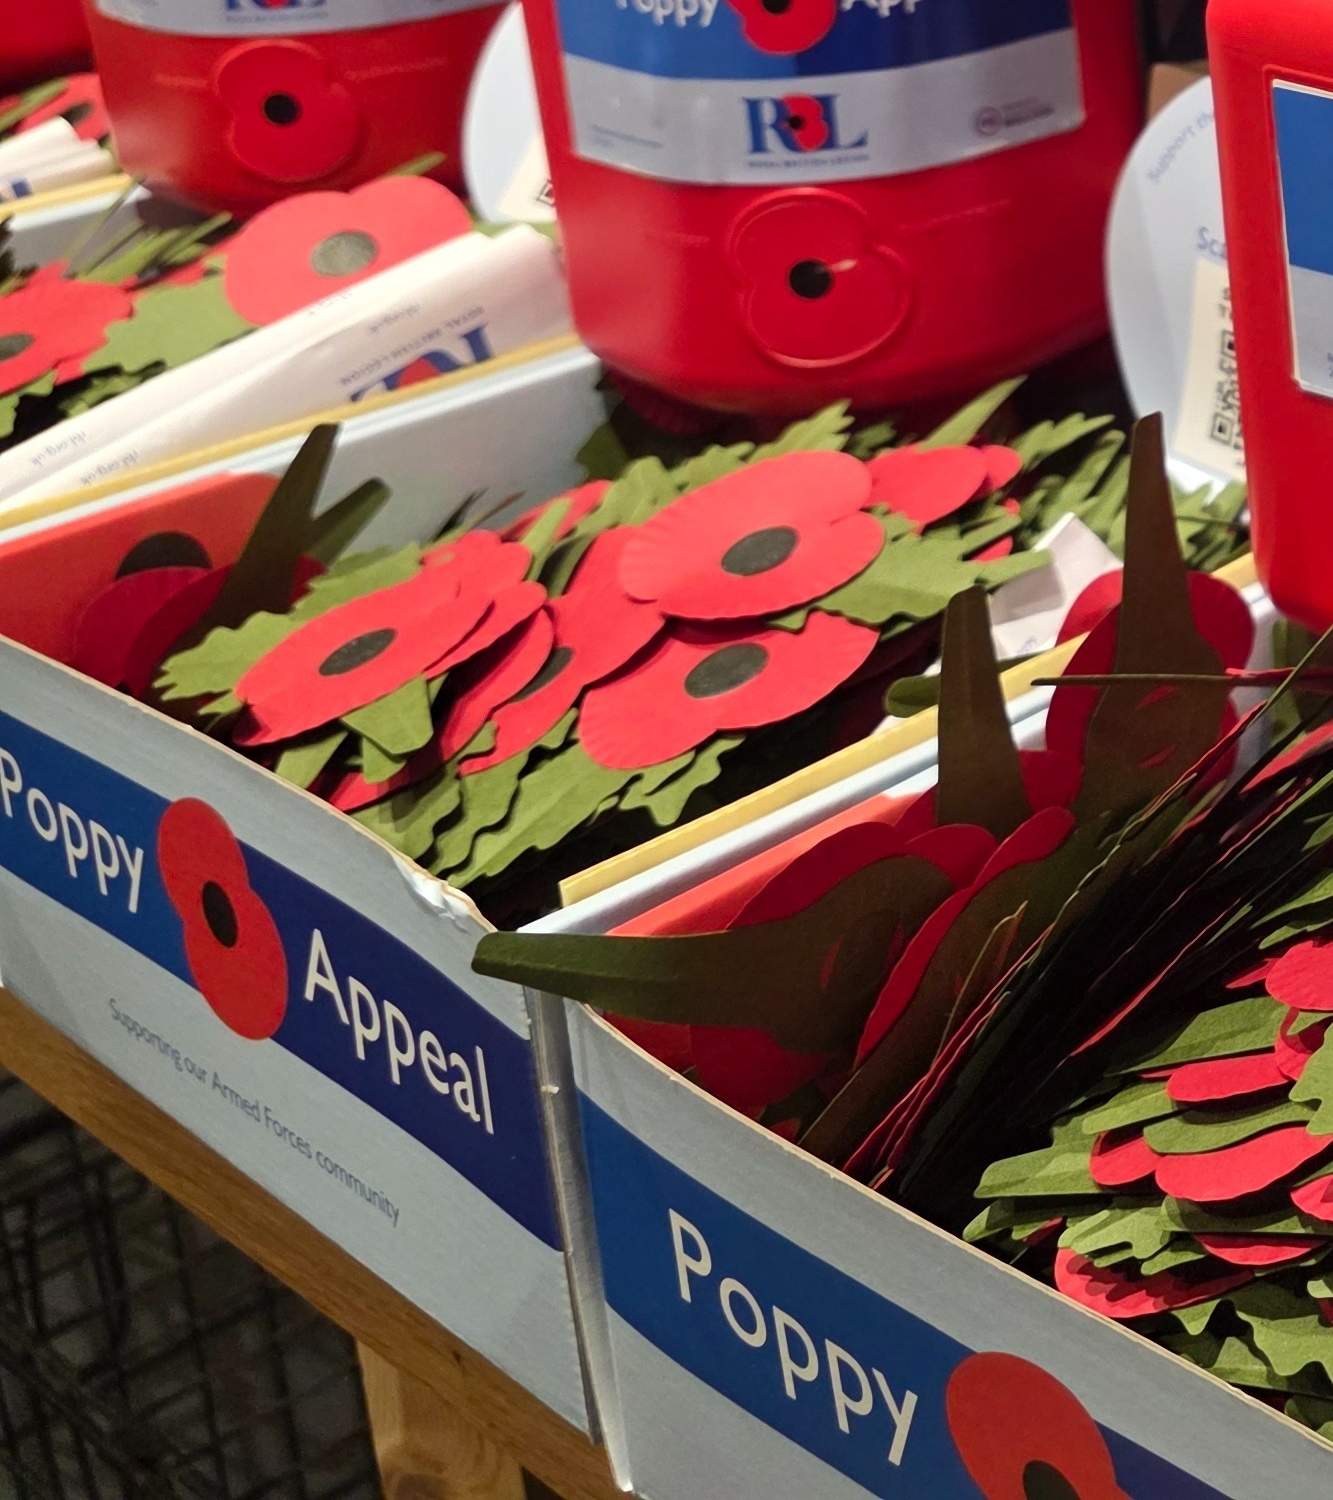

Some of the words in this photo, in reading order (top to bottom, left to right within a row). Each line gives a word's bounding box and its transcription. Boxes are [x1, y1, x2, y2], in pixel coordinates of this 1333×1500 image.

[0, 746, 144, 915] Poppy
[303, 927, 495, 1137] Appeal
[108, 997, 183, 1074] Supporting
[183, 1055, 208, 1085] our
[211, 1071, 262, 1124] Armed
[263, 1105, 313, 1160] Forces
[315, 1150, 400, 1228] community
[668, 1207, 919, 1467] Poppy
